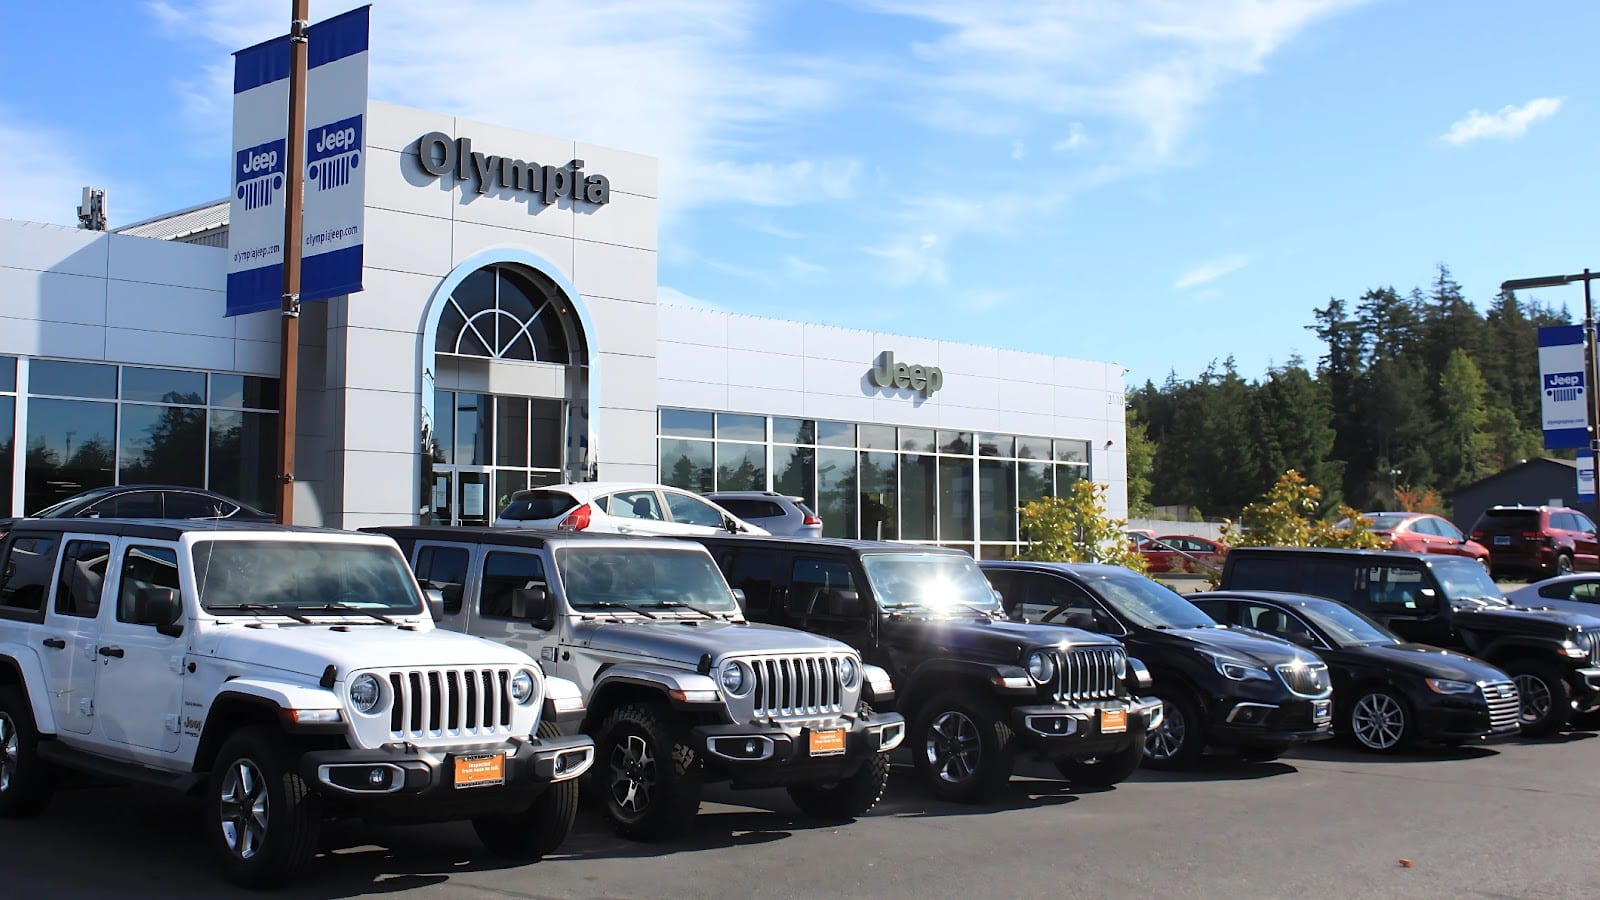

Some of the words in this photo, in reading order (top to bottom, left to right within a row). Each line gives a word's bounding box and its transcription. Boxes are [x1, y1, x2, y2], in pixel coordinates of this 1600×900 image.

[316, 127, 356, 153] Jeep
[243, 150, 278, 174] Jeep
[420, 131, 610, 205] Olympia
[306, 225, 358, 248] olympiajeep.com
[871, 350, 943, 398] Jeep
[1550, 374, 1579, 386] Jeep
